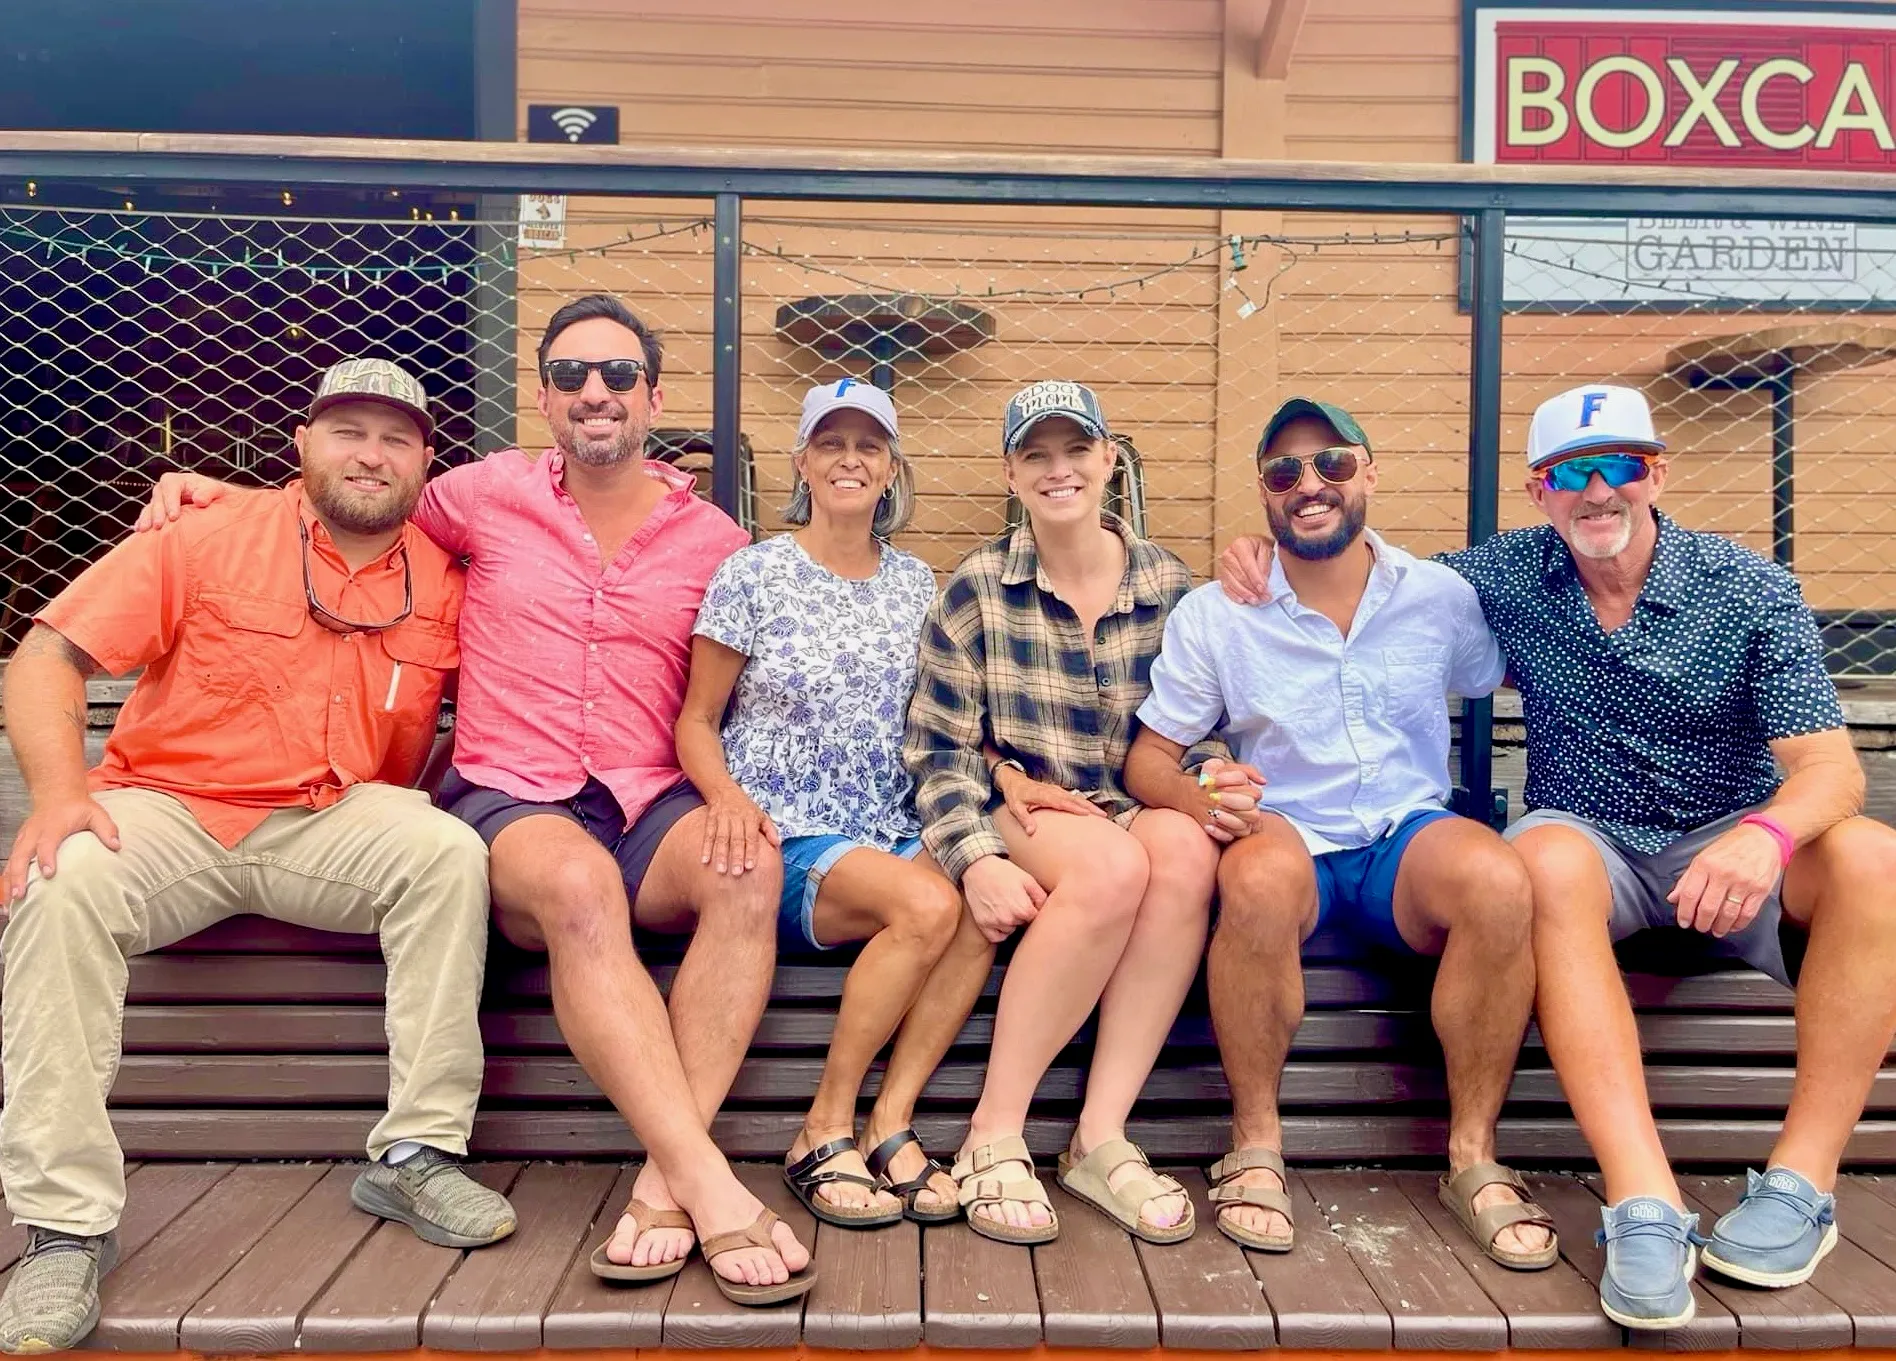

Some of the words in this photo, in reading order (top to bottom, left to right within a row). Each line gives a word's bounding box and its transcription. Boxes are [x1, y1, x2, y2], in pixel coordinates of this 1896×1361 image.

[1506, 55, 1896, 151] BOXCA
[1635, 234, 1849, 273] GARDEN
[1031, 383, 1074, 397] DOG
[1575, 392, 1608, 430] F
